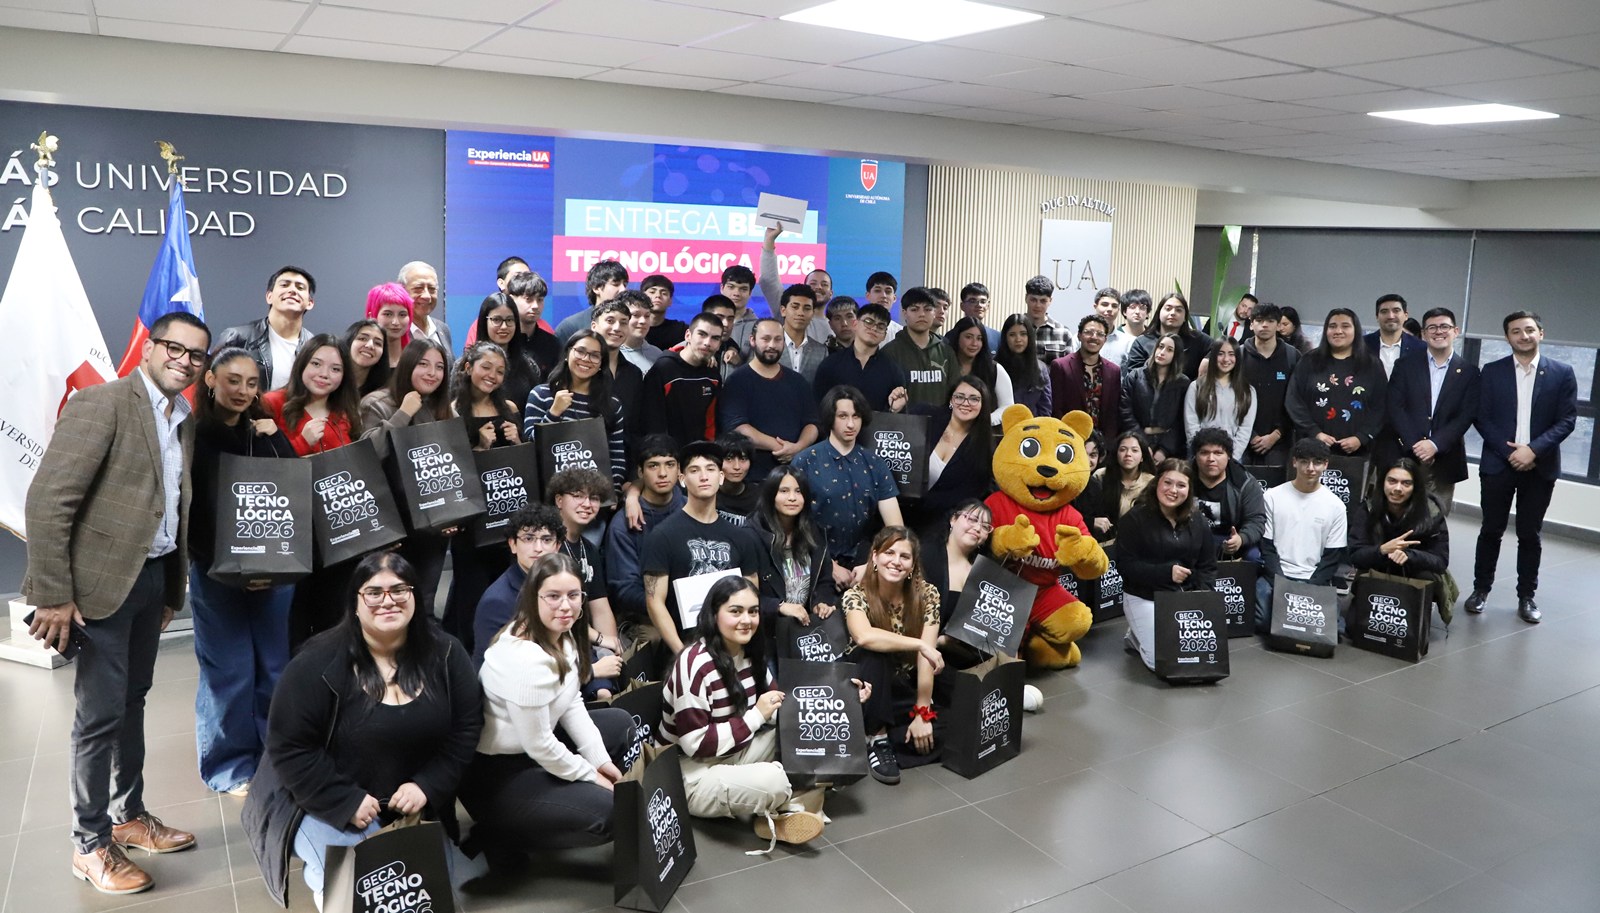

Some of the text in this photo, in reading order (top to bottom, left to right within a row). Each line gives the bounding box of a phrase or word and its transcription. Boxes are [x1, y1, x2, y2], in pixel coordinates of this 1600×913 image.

[75, 161, 348, 198] UNIVERSIDAD
[863, 171, 875, 180] UA
[1042, 195, 1116, 217] DUC IN ALTUM
[77, 207, 256, 237] CALIDAD
[585, 205, 804, 239] ENTREGA BE
[776, 253, 816, 276] 026
[1052, 258, 1098, 291] UA
[910, 369, 942, 383] PUMA
[878, 432, 899, 440] BECA
[411, 446, 435, 459] BECA
[555, 443, 577, 453] BECA
[875, 439, 911, 450] TECNO
[411, 452, 453, 470] TECNO
[554, 449, 593, 463] TECNO
[875, 446, 913, 461] LÓGICA
[414, 462, 461, 481] LÓGICA
[884, 457, 912, 473] 026
[319, 475, 345, 491] BECA
[484, 476, 524, 491] TECNO
[486, 470, 508, 481] BECA
[238, 484, 270, 494] BECA
[320, 479, 366, 502] TECNO
[417, 472, 464, 496] 2026
[1328, 484, 1350, 494] GICA
[235, 494, 290, 507] TECNO
[323, 489, 375, 515] LÓGICA
[486, 486, 528, 502] LÓGICA
[236, 505, 294, 521] LÓGICA
[487, 495, 529, 516] 2026
[327, 499, 379, 530] 2026
[235, 520, 295, 539] 2026
[983, 583, 1004, 599] BECA
[1214, 585, 1242, 594] TECNO
[1215, 579, 1231, 587] BECA
[979, 588, 1015, 613] TECNO
[1224, 594, 1245, 603] GICA
[1286, 598, 1322, 611] TECNO
[1289, 594, 1309, 603] BECA
[1373, 596, 1394, 605] BECA
[974, 598, 1014, 625] LÓGICA
[1178, 612, 1199, 620] BECA
[1286, 604, 1325, 619] LÓGICA
[1370, 602, 1407, 617] TECNO
[970, 608, 1013, 636] 2026
[1177, 619, 1213, 630] TECNO
[1286, 612, 1326, 628] 2026
[1369, 609, 1408, 627] LÓGICA
[1178, 628, 1217, 639] LÓGICA
[1367, 619, 1408, 638] 2026
[799, 636, 818, 647] BECA
[1179, 638, 1218, 652] 2026
[799, 642, 832, 661] TECNO
[799, 688, 827, 698] BECA
[796, 698, 845, 711] TECNO
[980, 696, 1007, 719] TECNO
[798, 709, 850, 724] LÓGICA
[980, 707, 1010, 730] LÓGICA
[799, 723, 851, 741] 2026
[980, 716, 1011, 745] 2026
[649, 795, 672, 831] TECNO
[652, 807, 678, 846] LÓGICA
[655, 818, 681, 864] 2026
[362, 867, 397, 891] BECA
[361, 873, 423, 907] TECNO
[365, 888, 432, 913] ÓGICA
